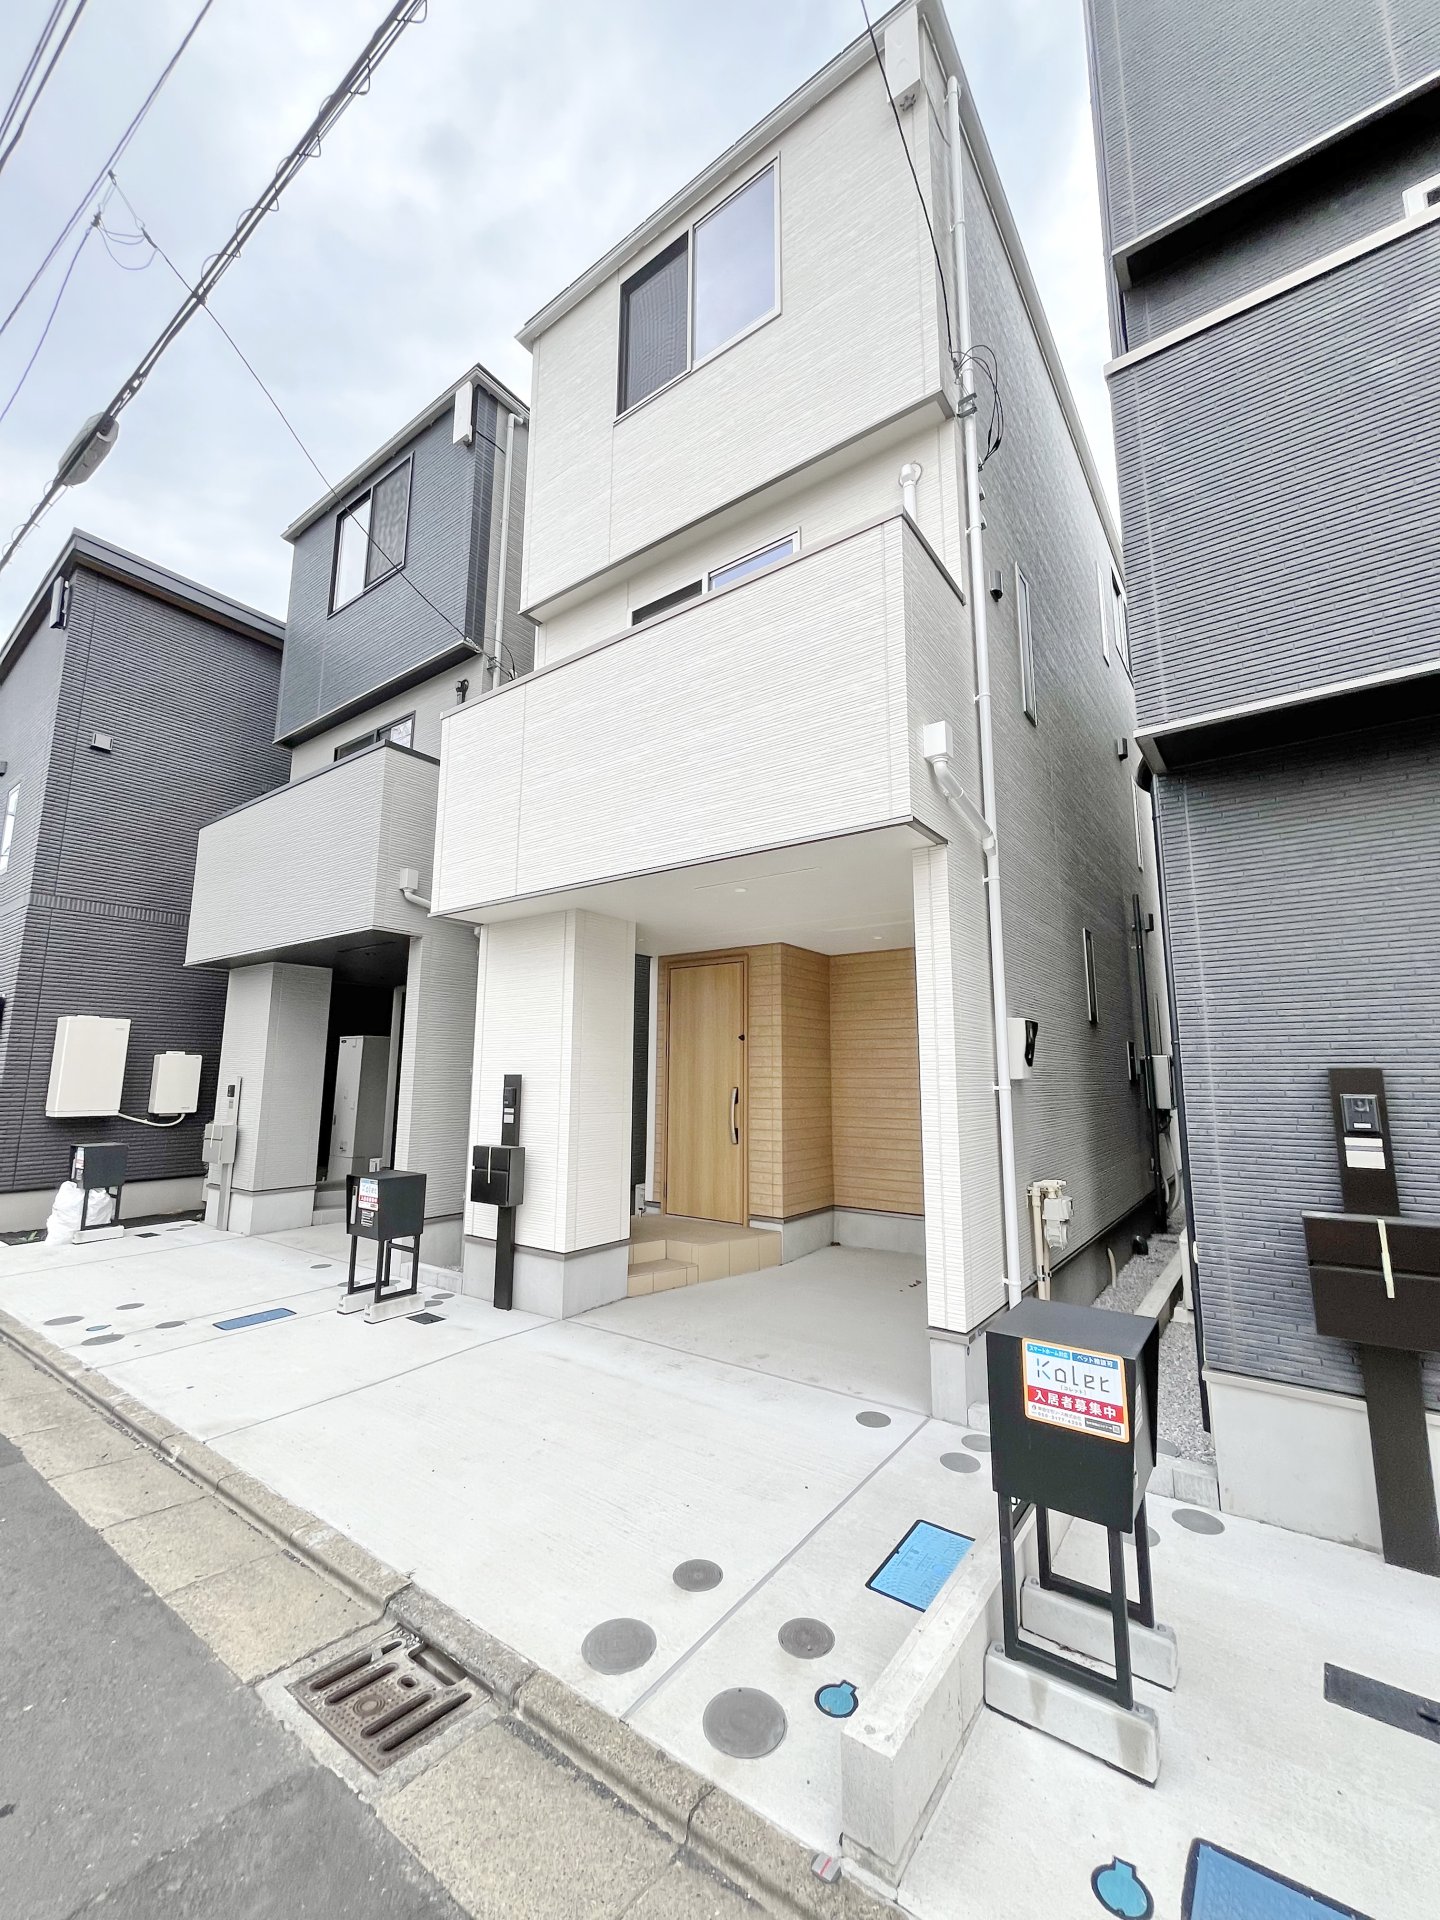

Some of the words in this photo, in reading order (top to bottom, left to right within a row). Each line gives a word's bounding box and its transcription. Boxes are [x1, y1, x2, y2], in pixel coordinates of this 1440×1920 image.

[1036, 1358, 1110, 1393] Kolet
[1034, 1389, 1117, 1419] 入居者募集中
